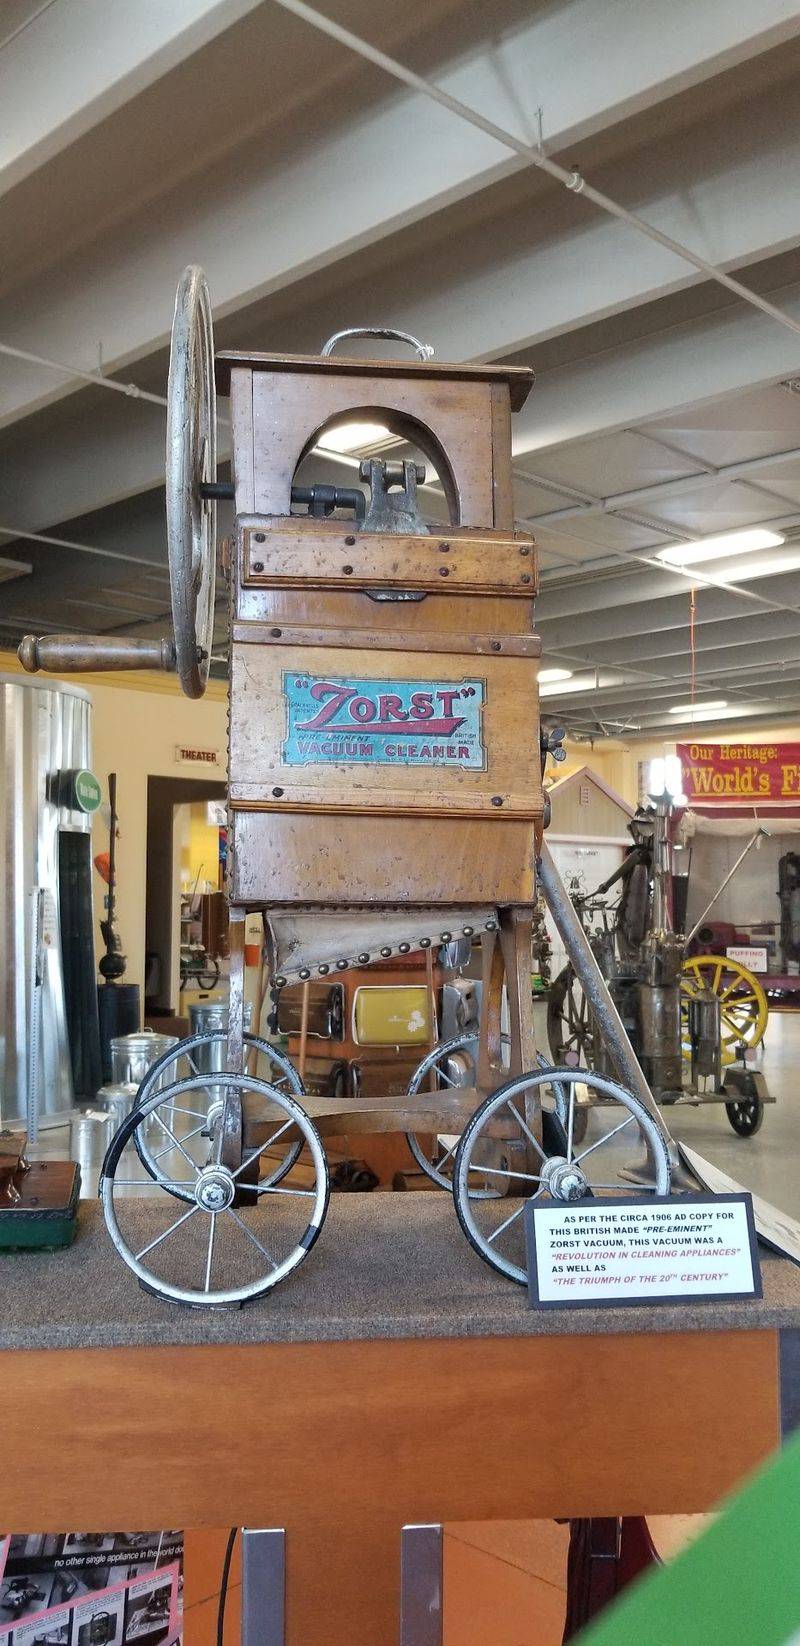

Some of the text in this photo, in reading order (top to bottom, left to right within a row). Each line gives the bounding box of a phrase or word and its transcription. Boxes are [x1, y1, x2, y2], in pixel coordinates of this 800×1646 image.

[180, 749, 217, 762] THEATER
[297, 742, 470, 758] VACUUM CLEANER
[690, 745, 777, 763] Our Heritage:
[574, 1227, 611, 1235] BRITISH
[550, 1240, 580, 1248] ZORST
[583, 1240, 626, 1248] VACUUM,
[653, 1238, 691, 1246] VACUUM
[552, 1252, 615, 1260] "REVOLUTION
[631, 1250, 677, 1258] CLEANING
[680, 1248, 741, 1257] APPLIANCES"
[553, 1277, 577, 1285] "THE
[579, 1276, 621, 1284] TRIUMPH
[624, 1275, 636, 1283] OF
[680, 1273, 728, 1281] CENTURY"
[54, 1560, 64, 1568] no
[66, 1557, 85, 1566] other
[86, 1555, 107, 1564] single
[107, 1553, 139, 1562] appliance
